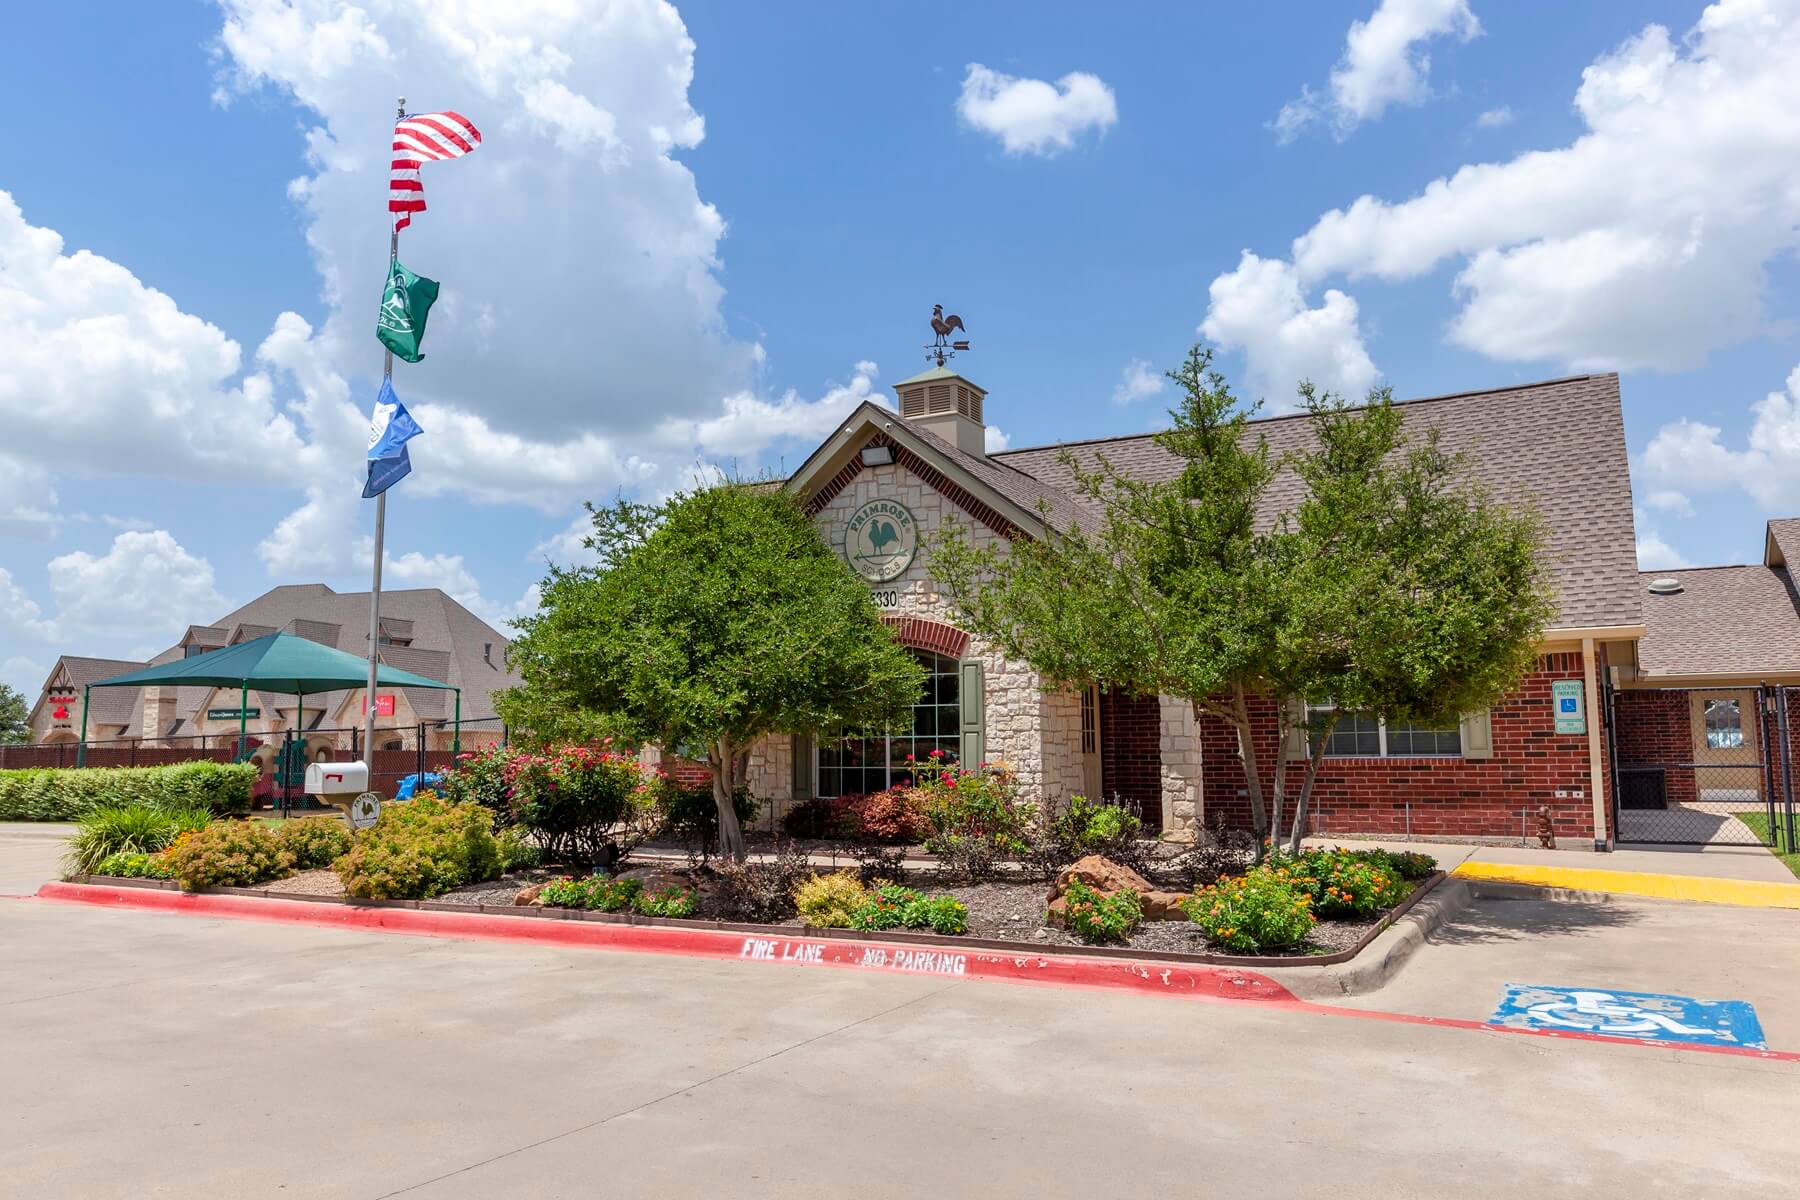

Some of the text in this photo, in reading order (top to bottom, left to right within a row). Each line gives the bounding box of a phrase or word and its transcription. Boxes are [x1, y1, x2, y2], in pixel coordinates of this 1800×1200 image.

[850, 503, 911, 532] PRIMROSE
[861, 561, 901, 576] SCHOOLS
[741, 938, 967, 976] FIRE LANE NO PARKING
